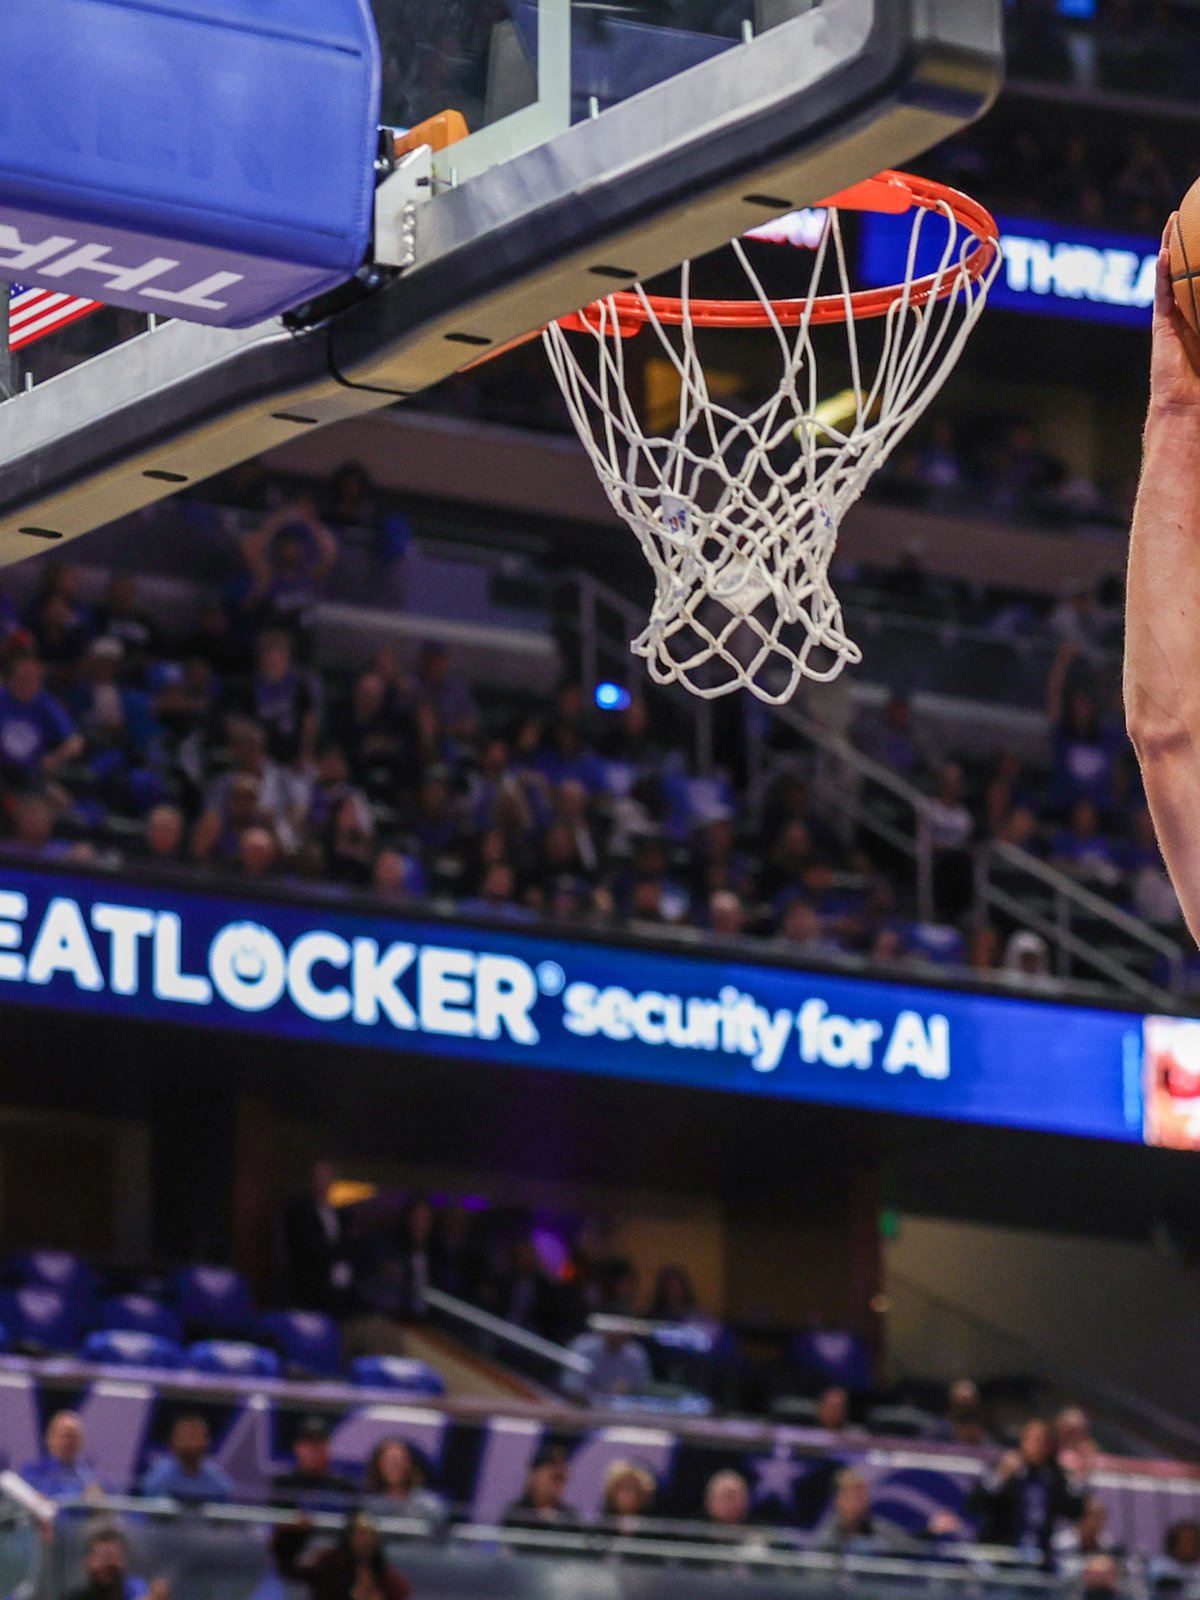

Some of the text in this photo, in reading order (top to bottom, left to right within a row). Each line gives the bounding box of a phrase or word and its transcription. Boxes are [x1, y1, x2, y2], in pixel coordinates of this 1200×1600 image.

[563, 982, 792, 1073] security
[797, 1000, 883, 1071] for
[882, 1010, 951, 1080] AI
